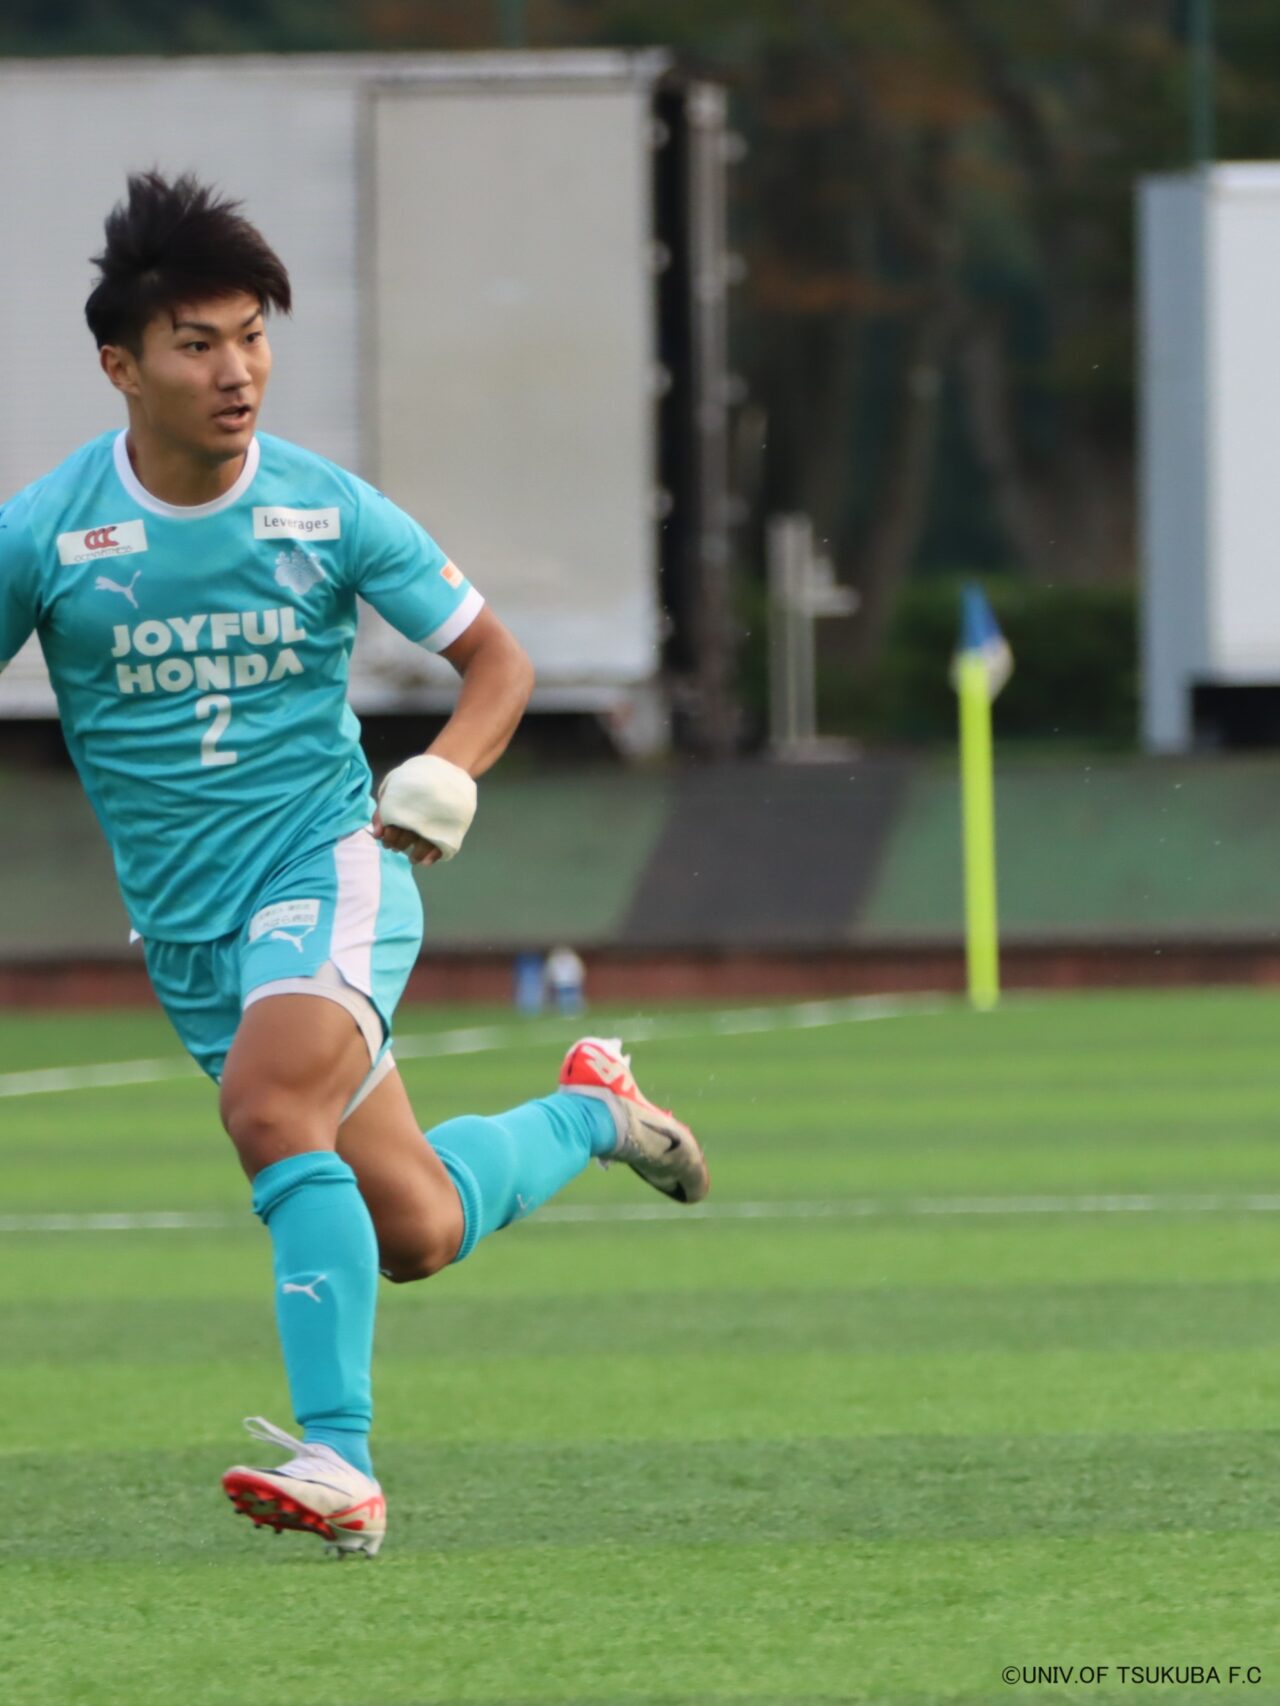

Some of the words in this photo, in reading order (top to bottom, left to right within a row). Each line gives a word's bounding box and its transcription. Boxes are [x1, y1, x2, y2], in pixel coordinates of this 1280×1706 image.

[263, 514, 330, 533] Leverages
[111, 606, 307, 658] JOYFUL
[116, 648, 305, 694] HONDA
[195, 693, 238, 767] 2
